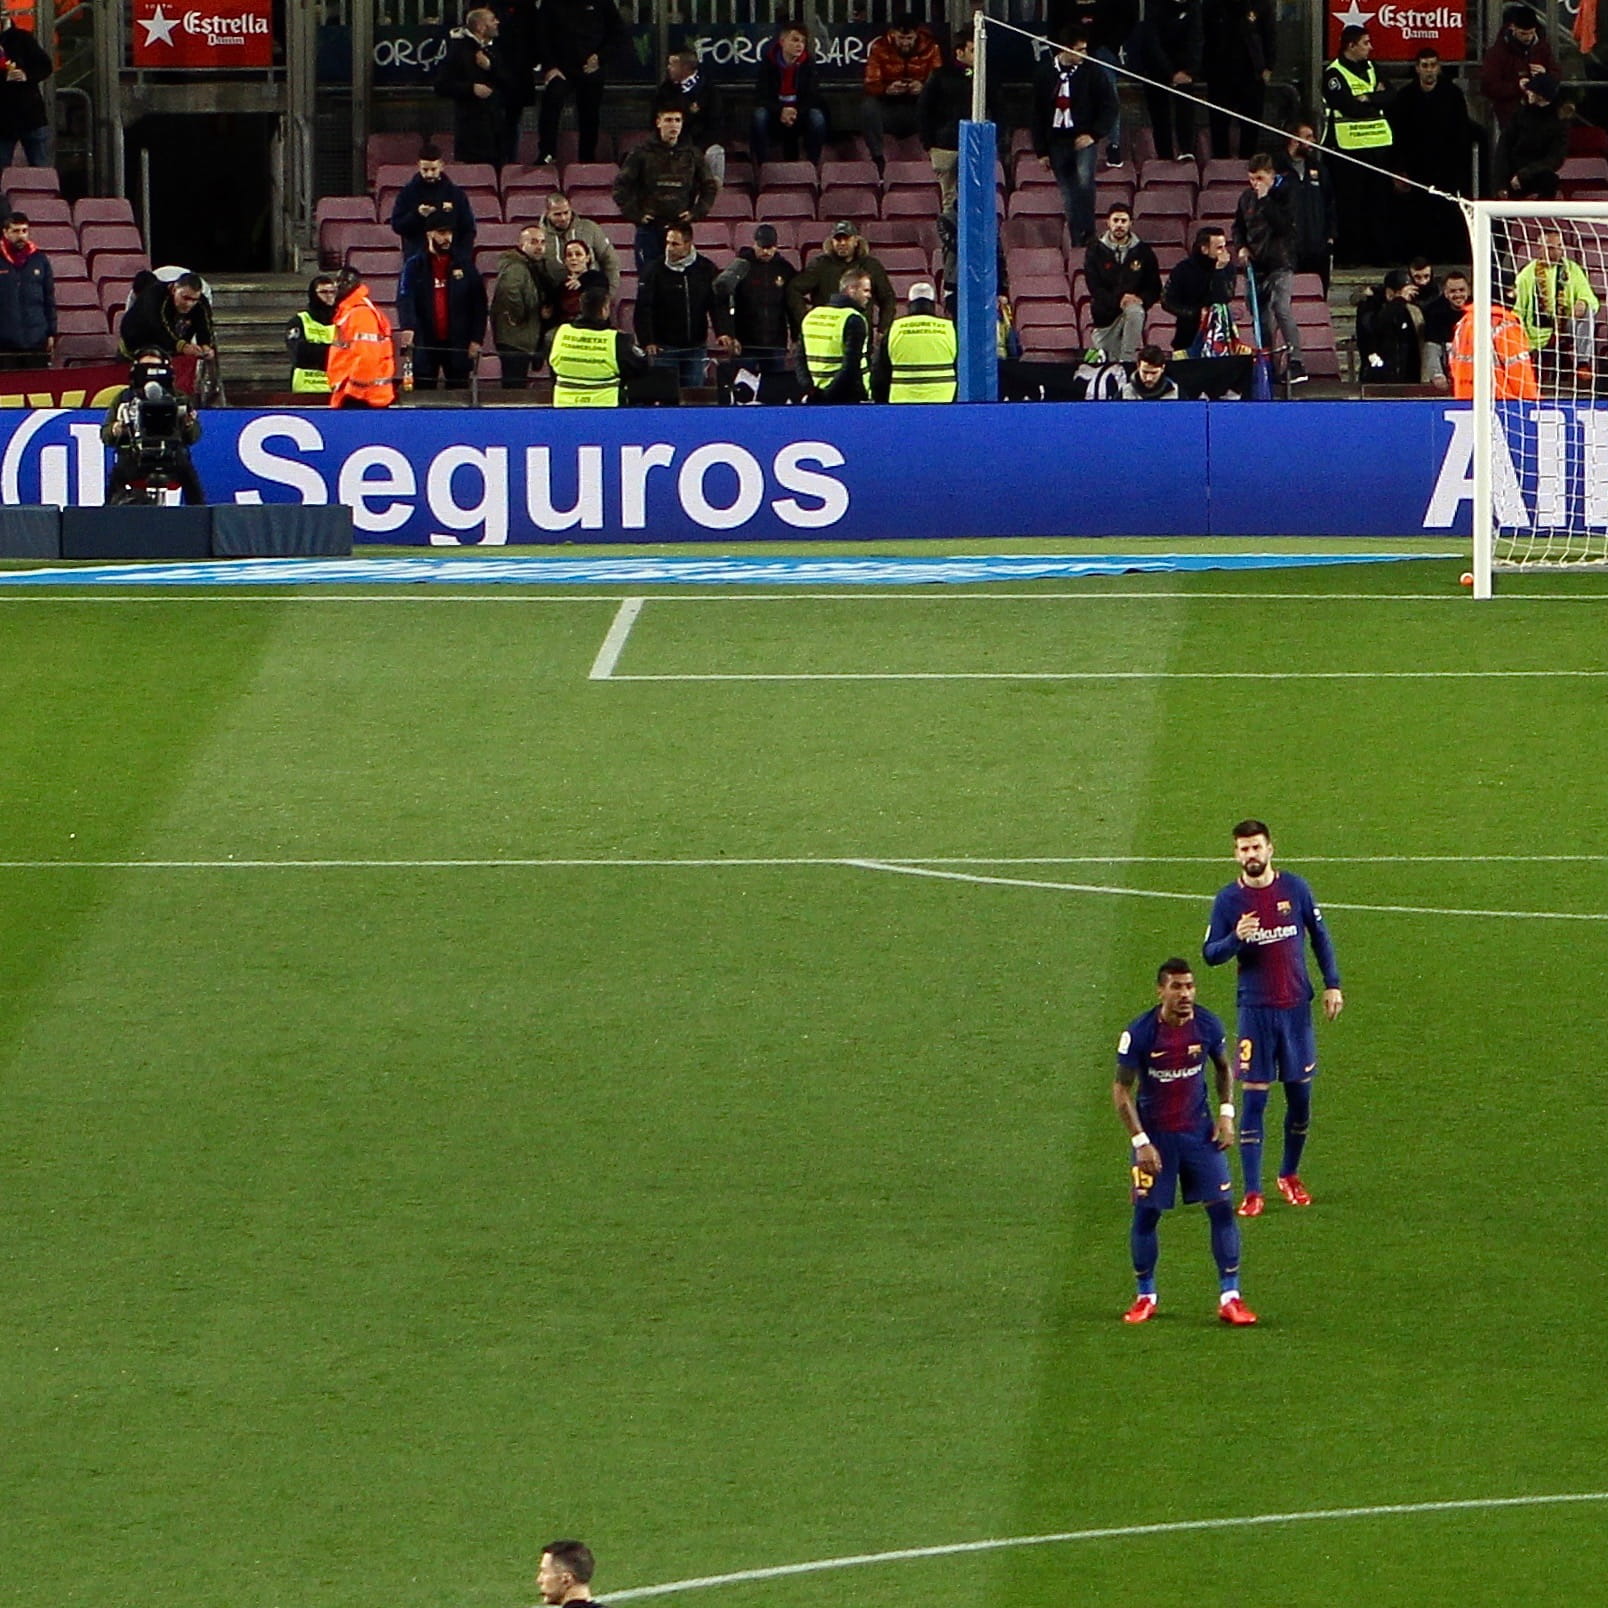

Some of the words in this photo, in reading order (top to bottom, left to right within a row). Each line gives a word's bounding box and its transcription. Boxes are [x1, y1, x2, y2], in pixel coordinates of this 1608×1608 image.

[183, 10, 268, 34] Estrella
[1378, 4, 1463, 28] Estrella
[207, 33, 244, 46] Damm
[1402, 27, 1439, 39] Damm
[373, 38, 447, 71] ORÇA
[235, 414, 850, 546] Seguros
[1239, 1039, 1253, 1061] 3
